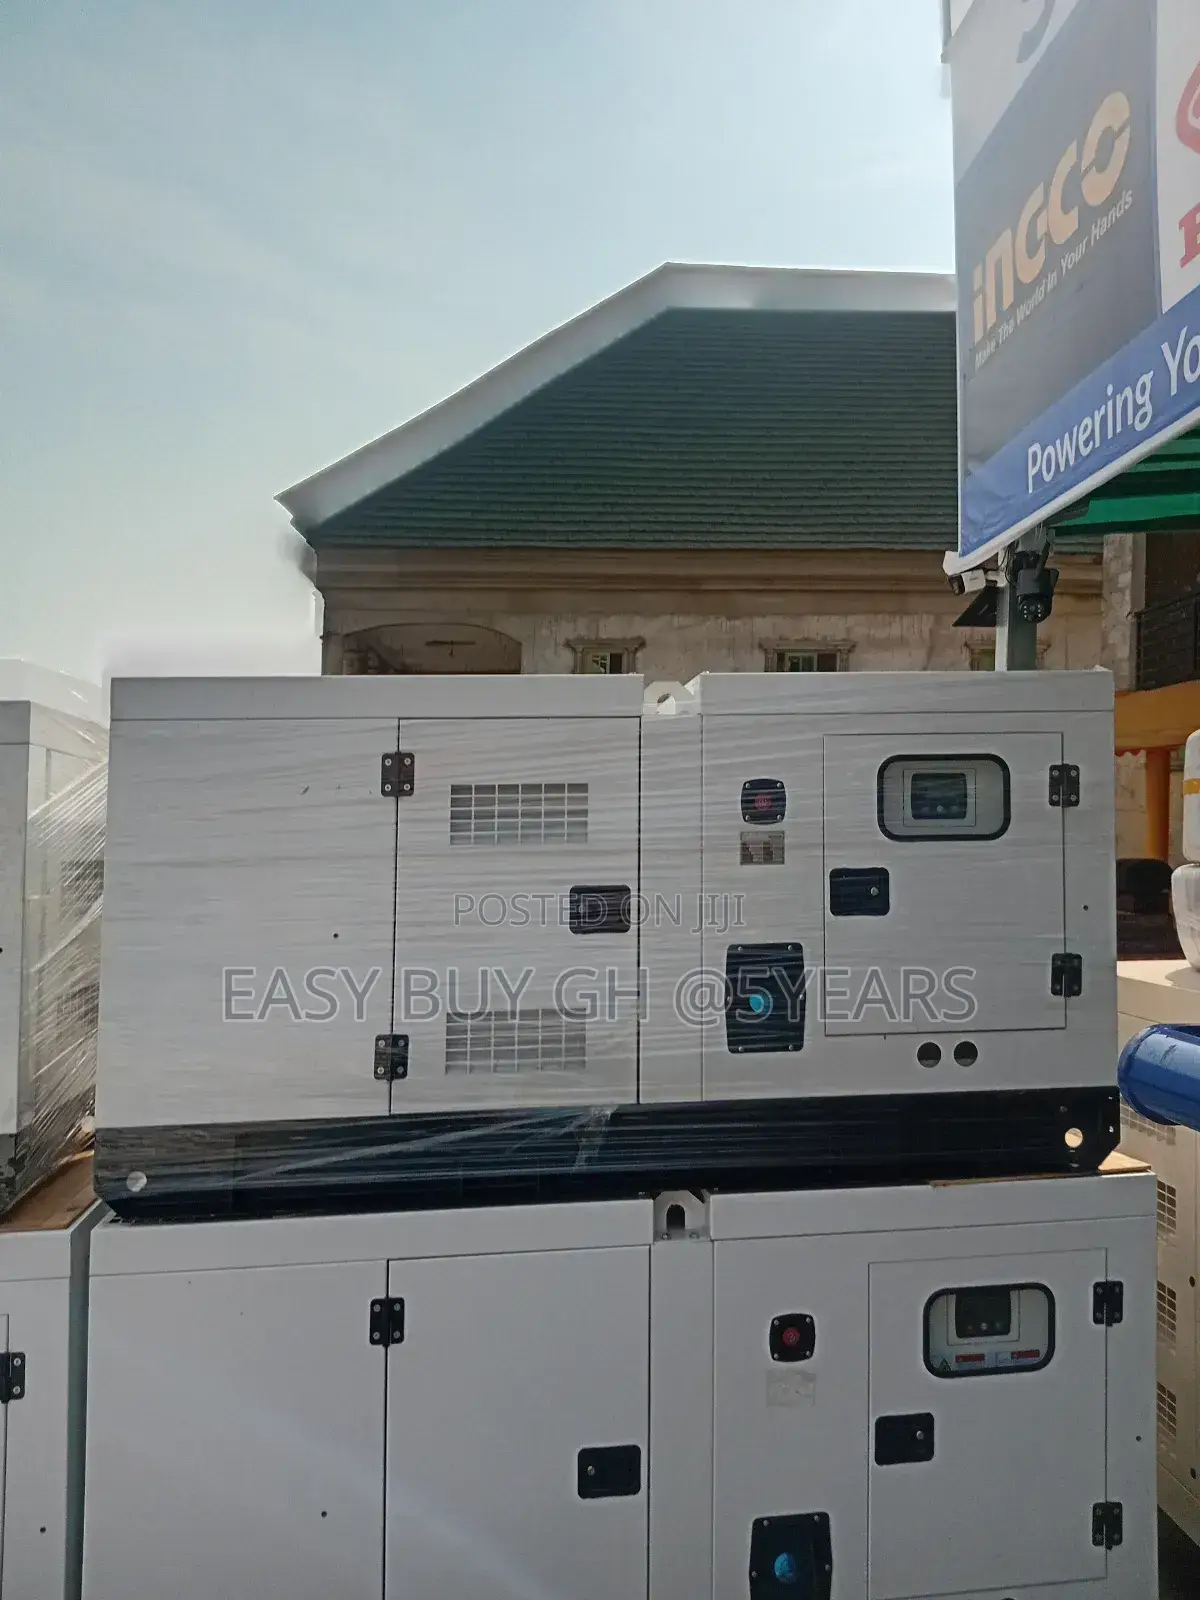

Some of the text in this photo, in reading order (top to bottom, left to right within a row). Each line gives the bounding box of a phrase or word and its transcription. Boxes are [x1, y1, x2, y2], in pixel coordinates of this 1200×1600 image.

[974, 189, 1133, 372] Make The World In Your Hands
[1027, 370, 1154, 494] Powering
